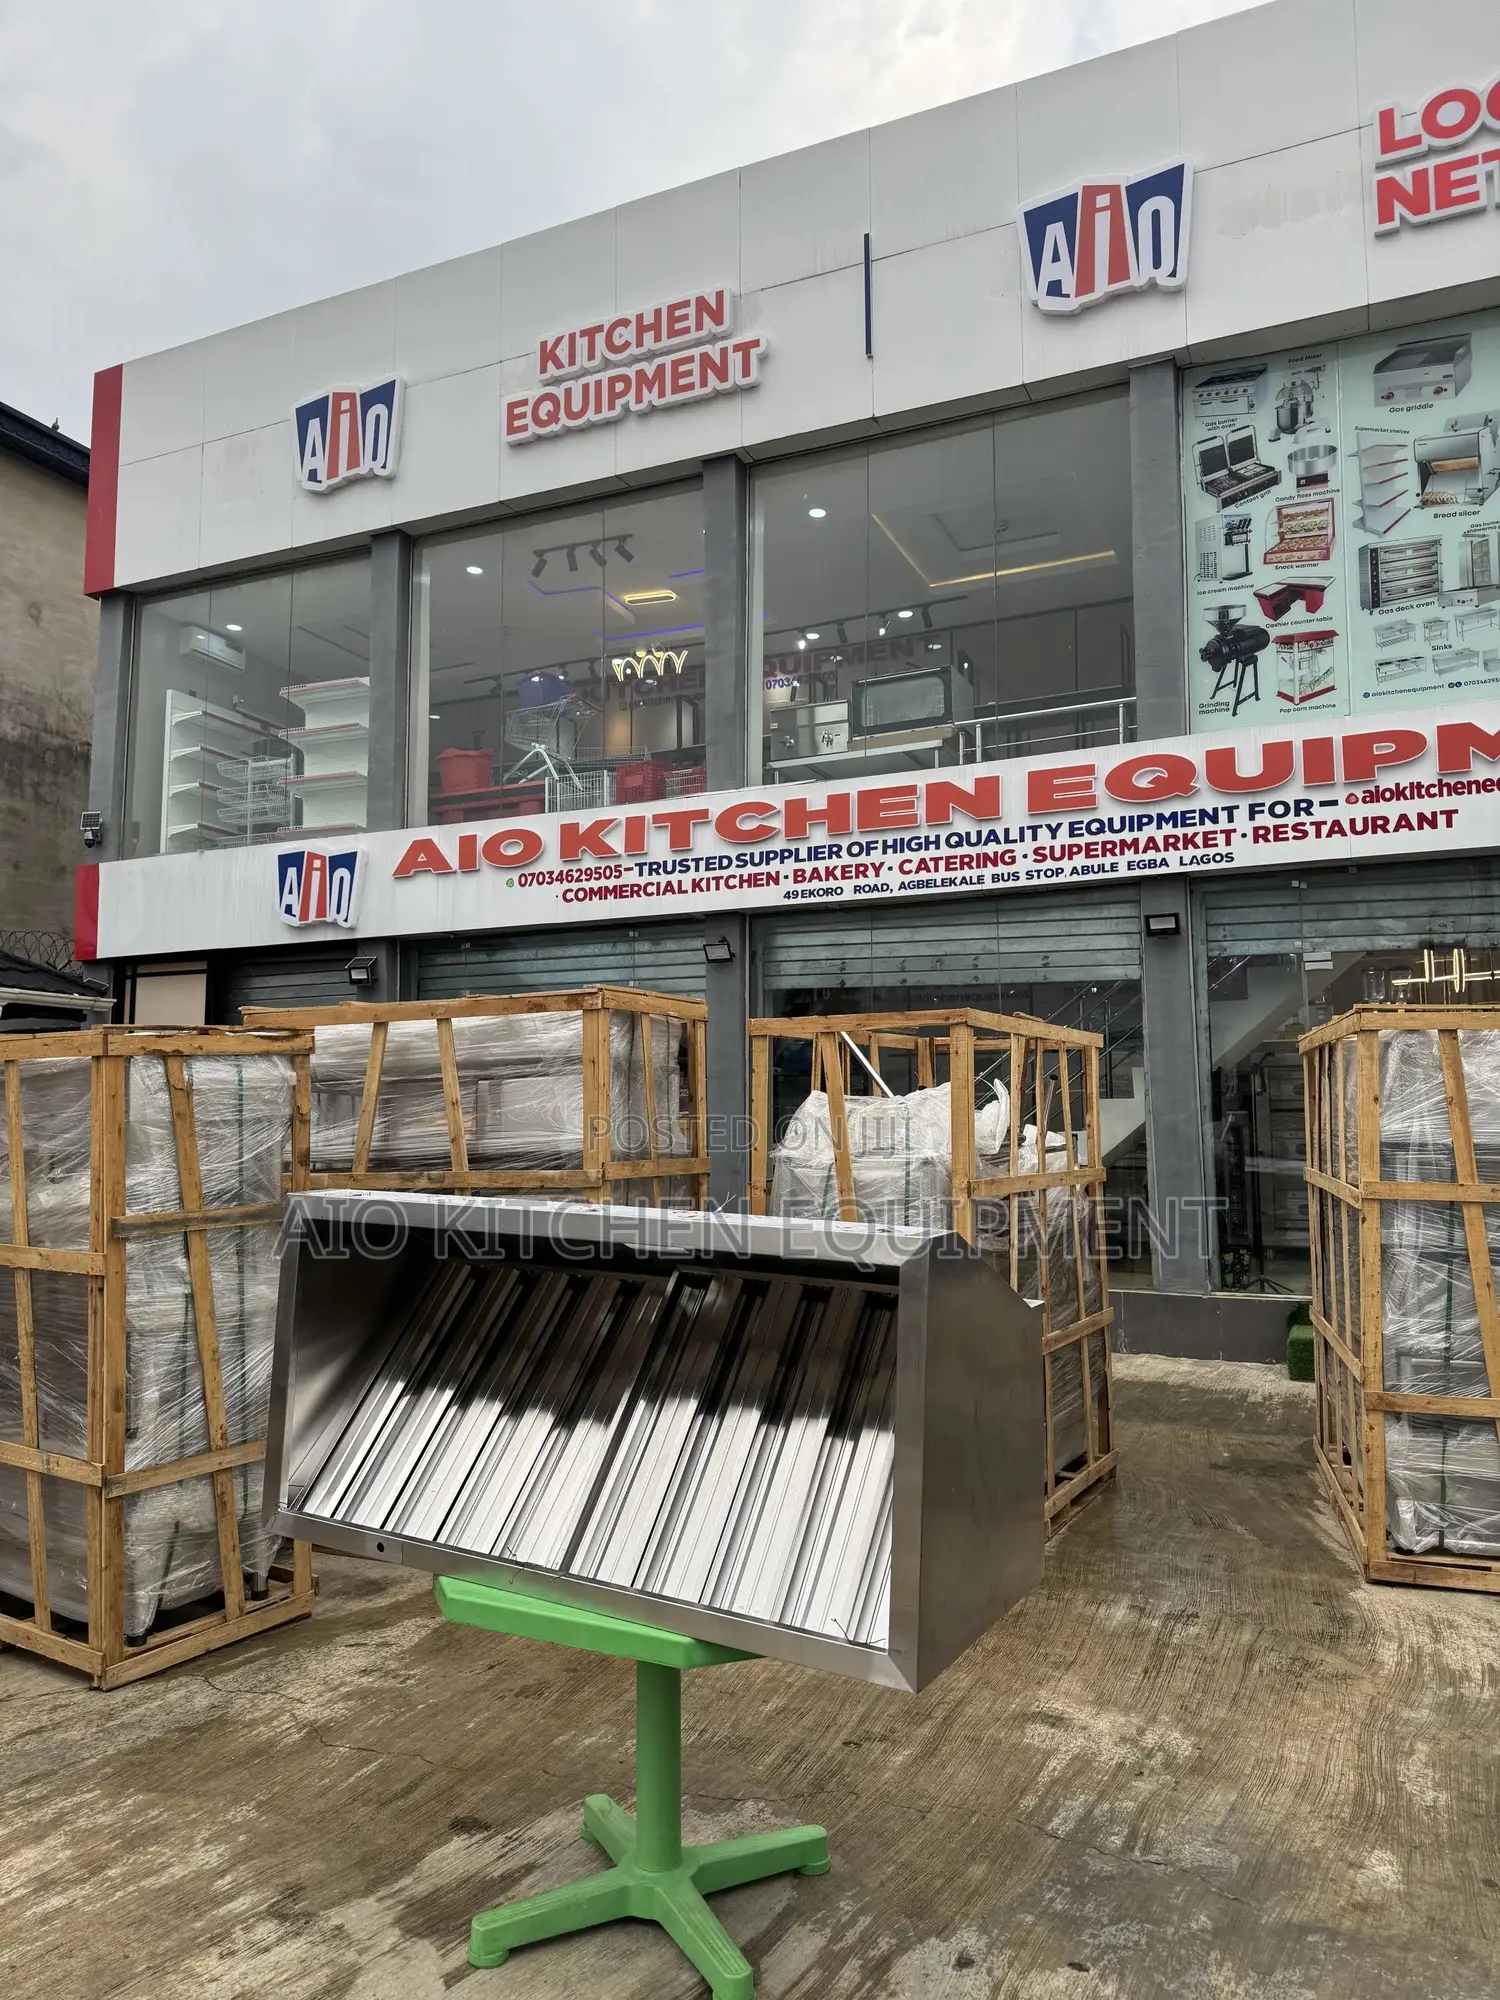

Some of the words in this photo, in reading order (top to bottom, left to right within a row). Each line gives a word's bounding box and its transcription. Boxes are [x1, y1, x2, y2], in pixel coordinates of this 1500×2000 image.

[1378, 80, 1500, 155] LO
[540, 289, 727, 374] KITCHEN
[1288, 356, 1304, 364] Food
[1304, 352, 1322, 361] Mixer
[505, 338, 762, 436] EQUIPMENT
[1406, 403, 1434, 413] griddle
[1205, 420, 1217, 428] Gas
[1218, 417, 1238, 426] burner
[1207, 424, 1220, 432] with
[1221, 422, 1236, 430] oven
[1354, 425, 1388, 434] Supermarket
[1389, 427, 1410, 435] shelves
[1234, 495, 1260, 508] Contact
[1260, 489, 1272, 500] grill
[1275, 494, 1296, 503] Candy
[1296, 491, 1312, 499] floss
[1312, 487, 1341, 497] machine
[1433, 511, 1457, 519] Bread
[1458, 509, 1481, 517] slicer
[1207, 587, 1227, 595] cream
[1228, 583, 1254, 592] machine
[1378, 607, 1394, 615] Gas
[1395, 602, 1415, 612] deck
[1415, 600, 1436, 608] oven
[1265, 621, 1289, 629] Cashier
[1290, 618, 1315, 626] counter
[1315, 615, 1333, 623] table
[1371, 684, 1445, 697] aiokitchenequipment
[1463, 677, 1500, 686] 070346295
[1199, 701, 1229, 709] Grinding
[1199, 707, 1229, 715] machine
[1308, 703, 1336, 711] machine
[392, 828, 544, 878] AIO
[560, 774, 1001, 861] KITCHEN
[735, 843, 843, 868] SUPPLIER
[847, 839, 879, 858] OF
[881, 834, 940, 854] HIGH
[944, 822, 1063, 849] QUALITY
[1068, 804, 1240, 838] EQUIPMENT
[562, 882, 688, 904] COMMERCIAL
[691, 870, 781, 893] KITCHEN
[792, 861, 885, 884] BAKERY
[898, 848, 1017, 874] CATERING
[1031, 828, 1238, 864] SUPERMARKET
[1252, 808, 1459, 844] RESTAURANT
[783, 890, 799, 900] 49
[800, 886, 844, 899] EKORO
[853, 882, 893, 895] ROAD,
[898, 874, 985, 891] AGBELEKALE
[991, 871, 1021, 884] BUS
[1069, 862, 1120, 877] ABULE
[1126, 858, 1170, 871] EGBA
[1178, 852, 1235, 866] LAGOS
